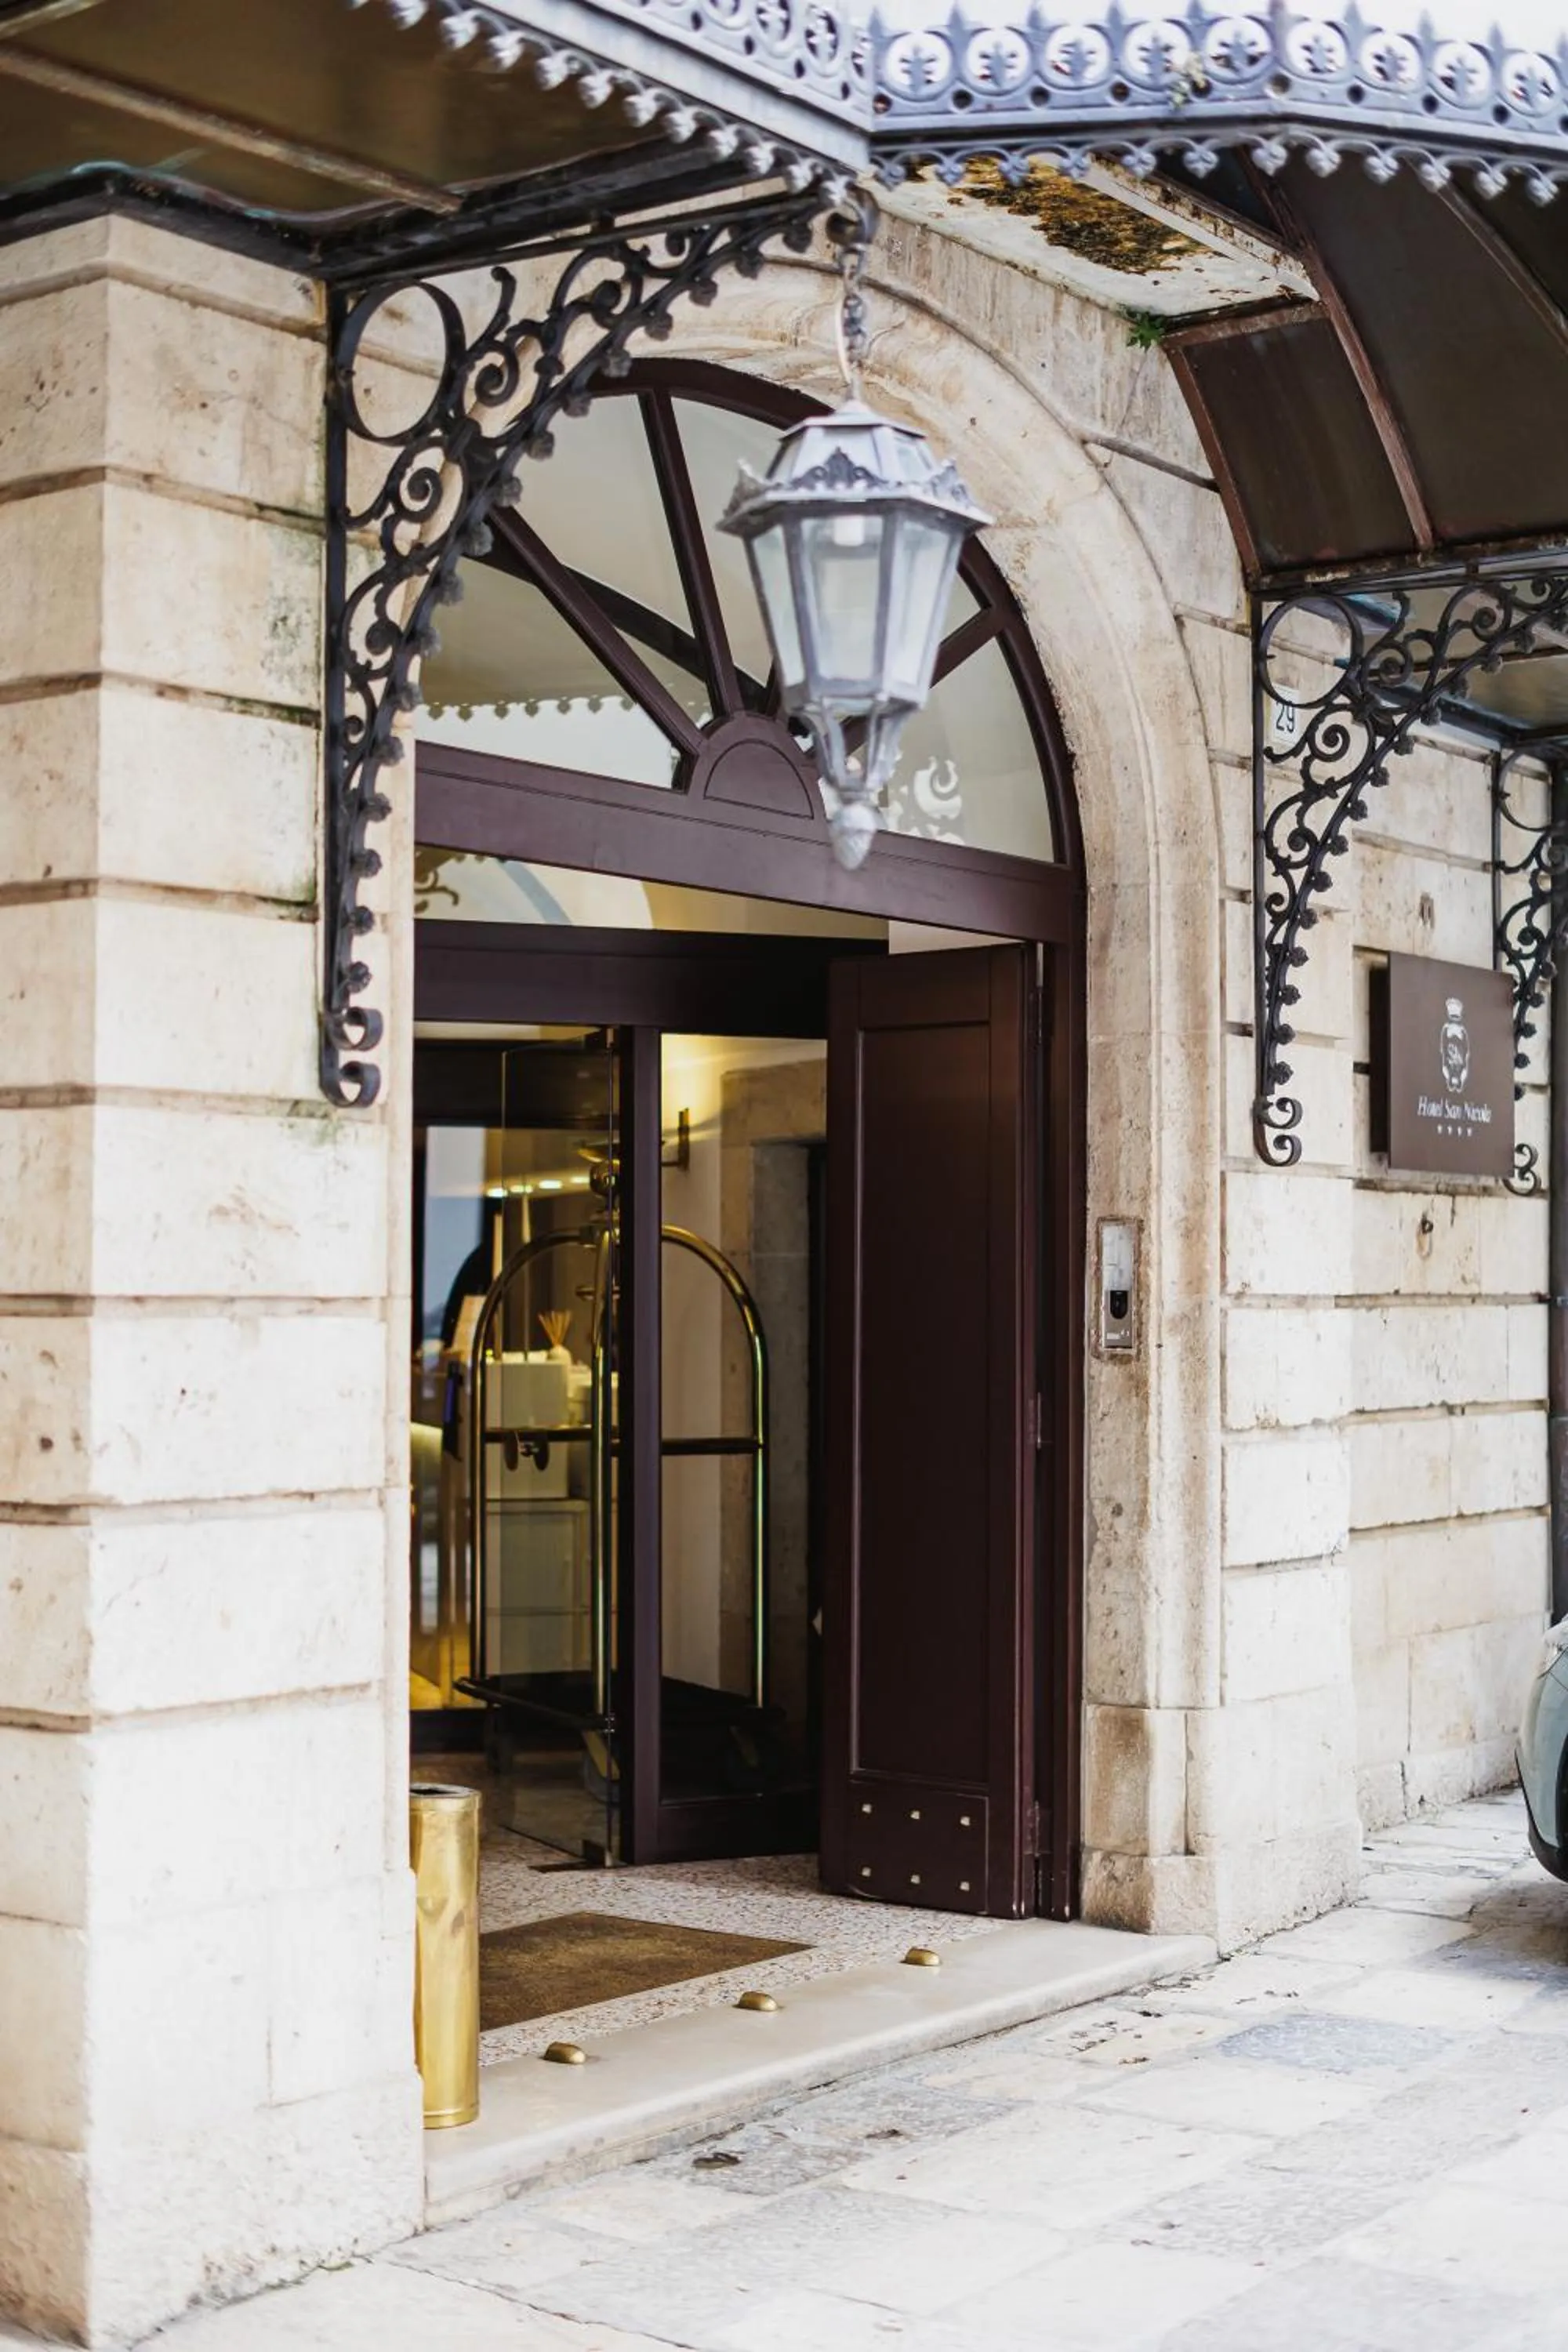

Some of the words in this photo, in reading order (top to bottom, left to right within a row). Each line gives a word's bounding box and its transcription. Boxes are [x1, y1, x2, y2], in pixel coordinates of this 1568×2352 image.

[1276, 702, 1294, 734] 29
[1417, 1096, 1443, 1117] Hotel
[1444, 1098, 1461, 1120] San
